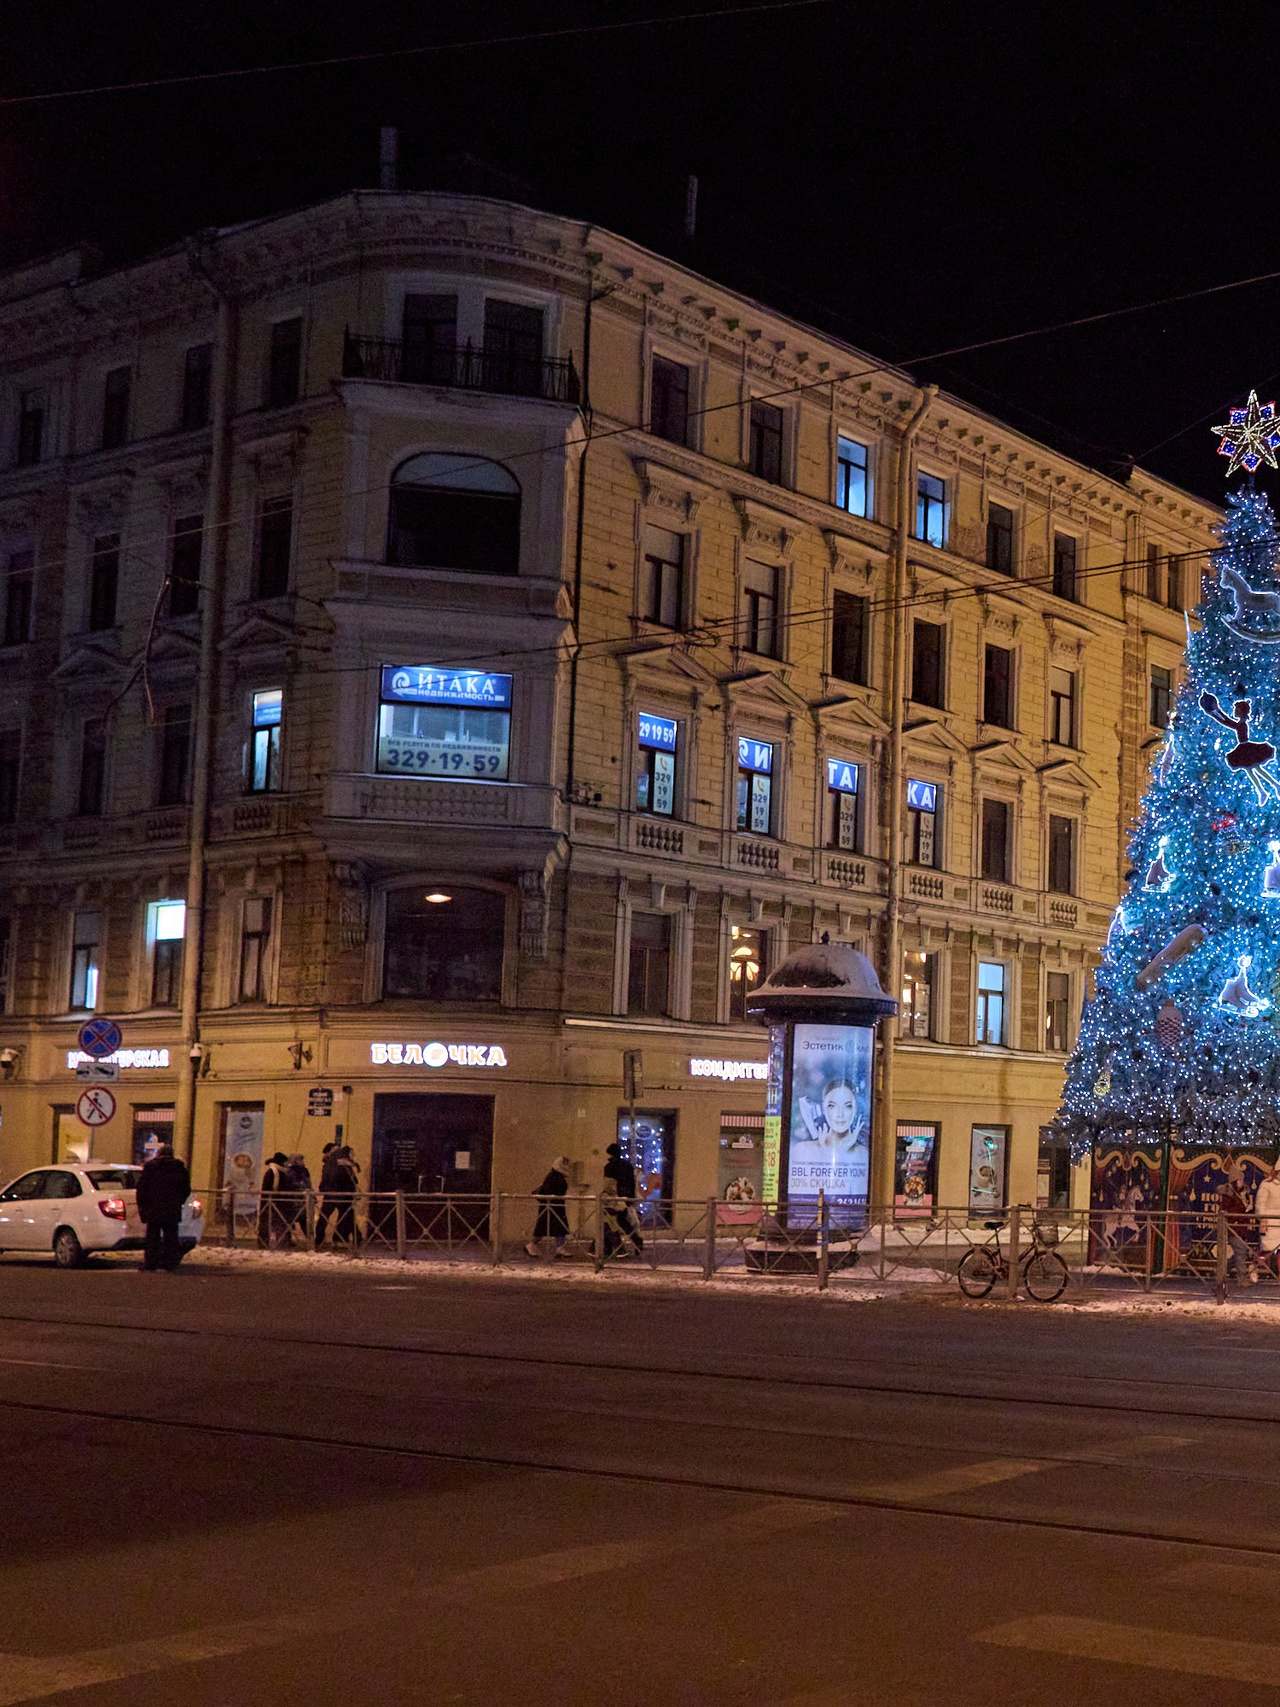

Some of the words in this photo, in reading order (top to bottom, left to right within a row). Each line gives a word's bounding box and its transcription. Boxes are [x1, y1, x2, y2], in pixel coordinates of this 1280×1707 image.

[418, 673, 495, 694] ИТАКА
[418, 689, 494, 701] недвижимость
[639, 722, 650, 737] 29
[652, 726, 662, 741] 19
[663, 728, 674, 743] 59
[655, 772, 671, 783] 329
[658, 786, 667, 796] 19
[753, 793, 767, 803] 329
[656, 799, 667, 809] 59
[755, 806, 764, 816] 19
[754, 818, 764, 829] 59
[842, 824, 850, 833] 19
[841, 835, 850, 845] 59
[921, 851, 929, 860] 59
[802, 1041, 844, 1052] Эстетик
[810, 1167, 848, 1178] FOREVER
[809, 1179, 845, 1189] СКИДКА
